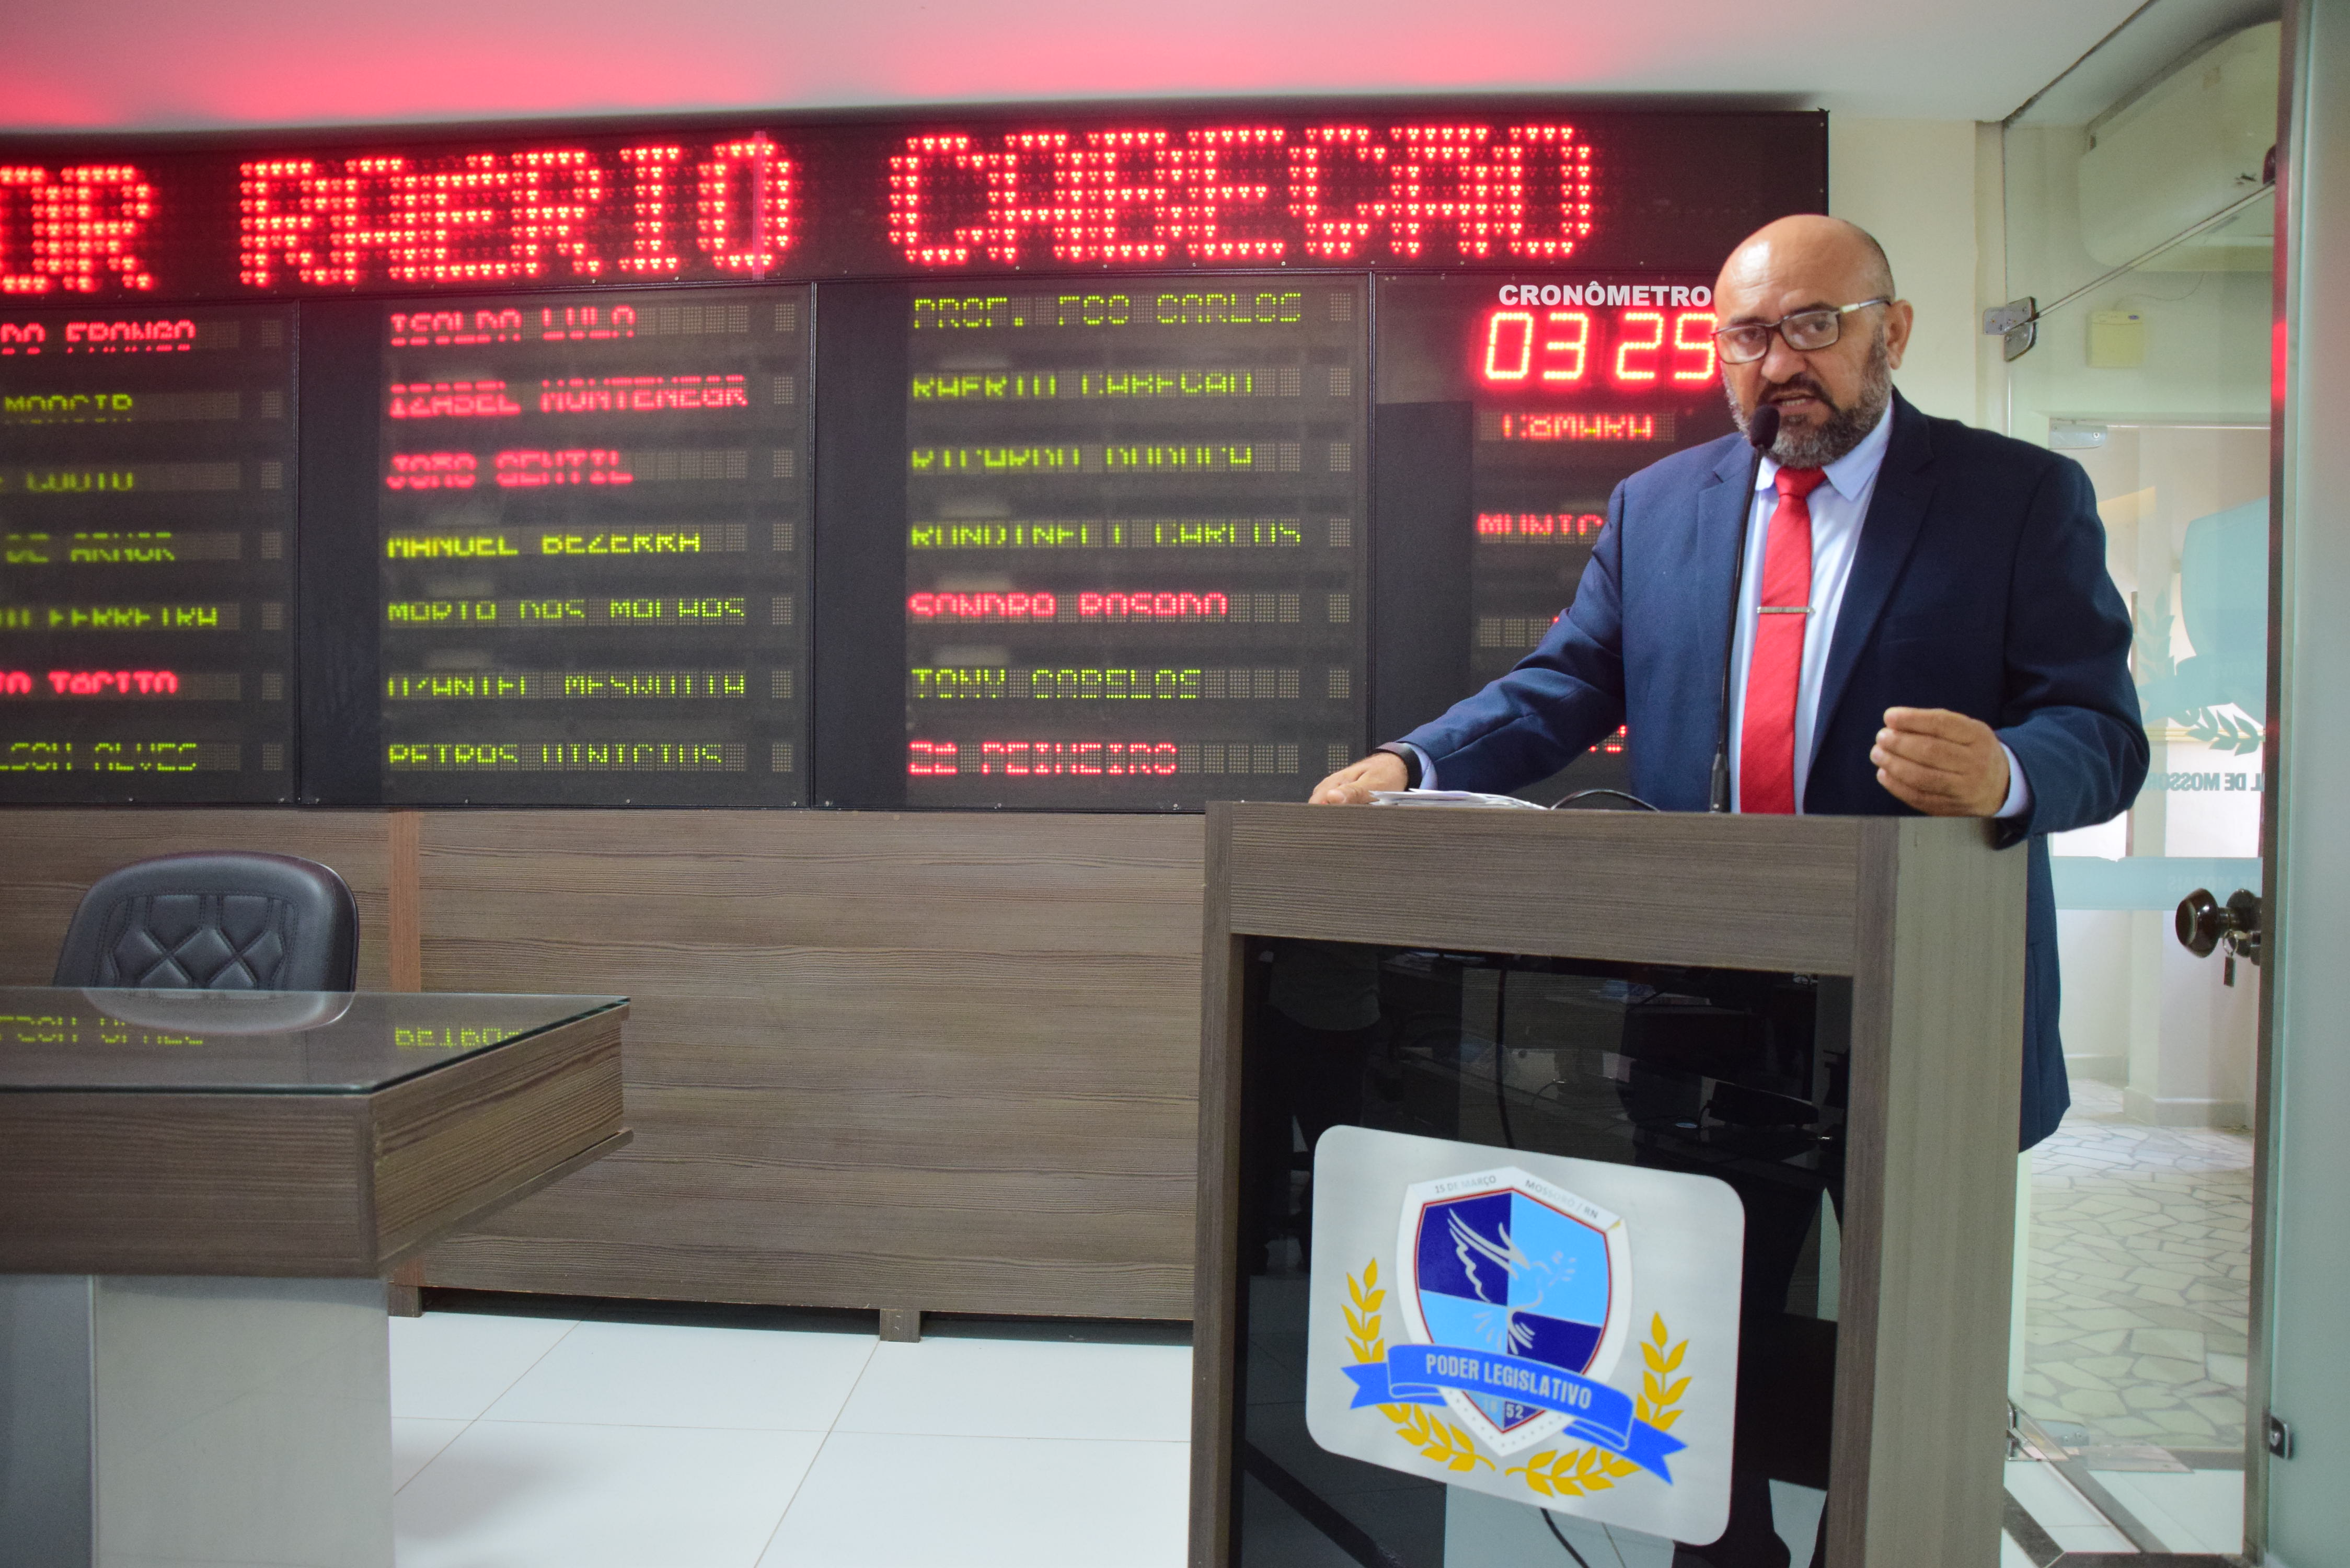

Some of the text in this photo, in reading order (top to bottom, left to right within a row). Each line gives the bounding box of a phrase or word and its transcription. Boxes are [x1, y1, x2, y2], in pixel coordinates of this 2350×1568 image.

[1499, 281, 1712, 307] CRONÔMETRO
[1425, 1353, 1593, 1411] PODER LEGISLATIVO
